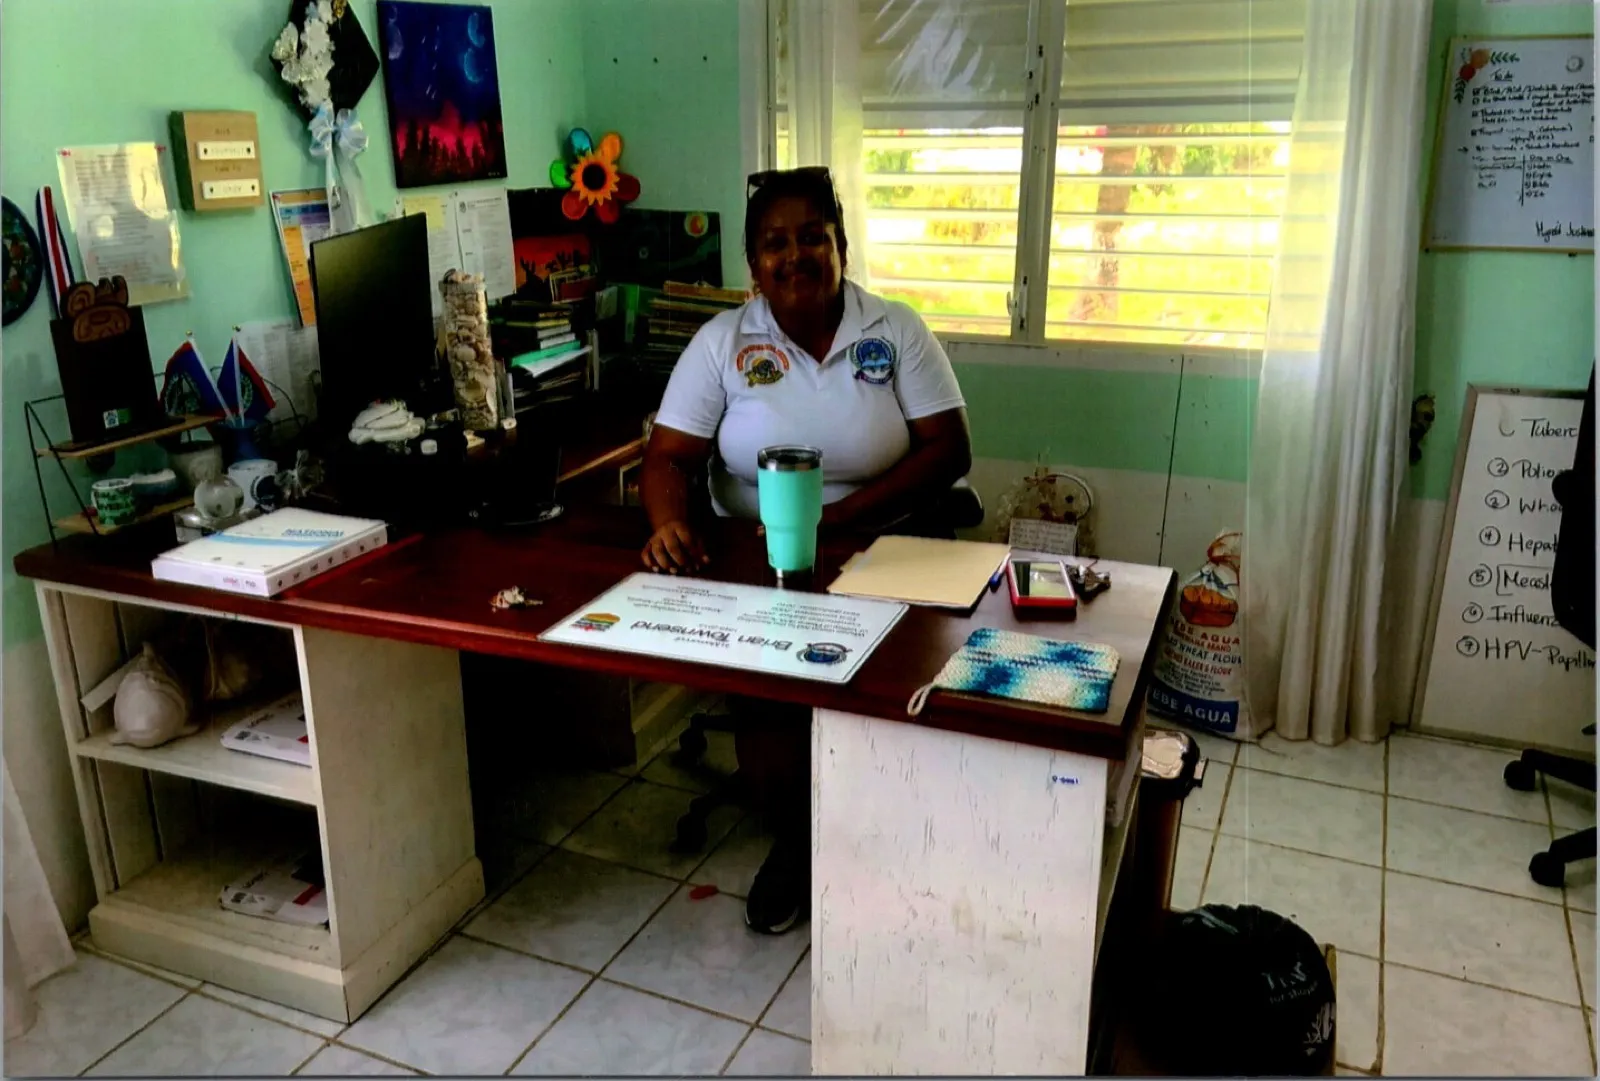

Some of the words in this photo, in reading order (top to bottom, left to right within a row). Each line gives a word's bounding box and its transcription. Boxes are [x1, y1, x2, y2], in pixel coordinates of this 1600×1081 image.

[1512, 458, 1555, 479] Polio
[630, 620, 730, 642] Townsend
[738, 635, 793, 651] Brian
